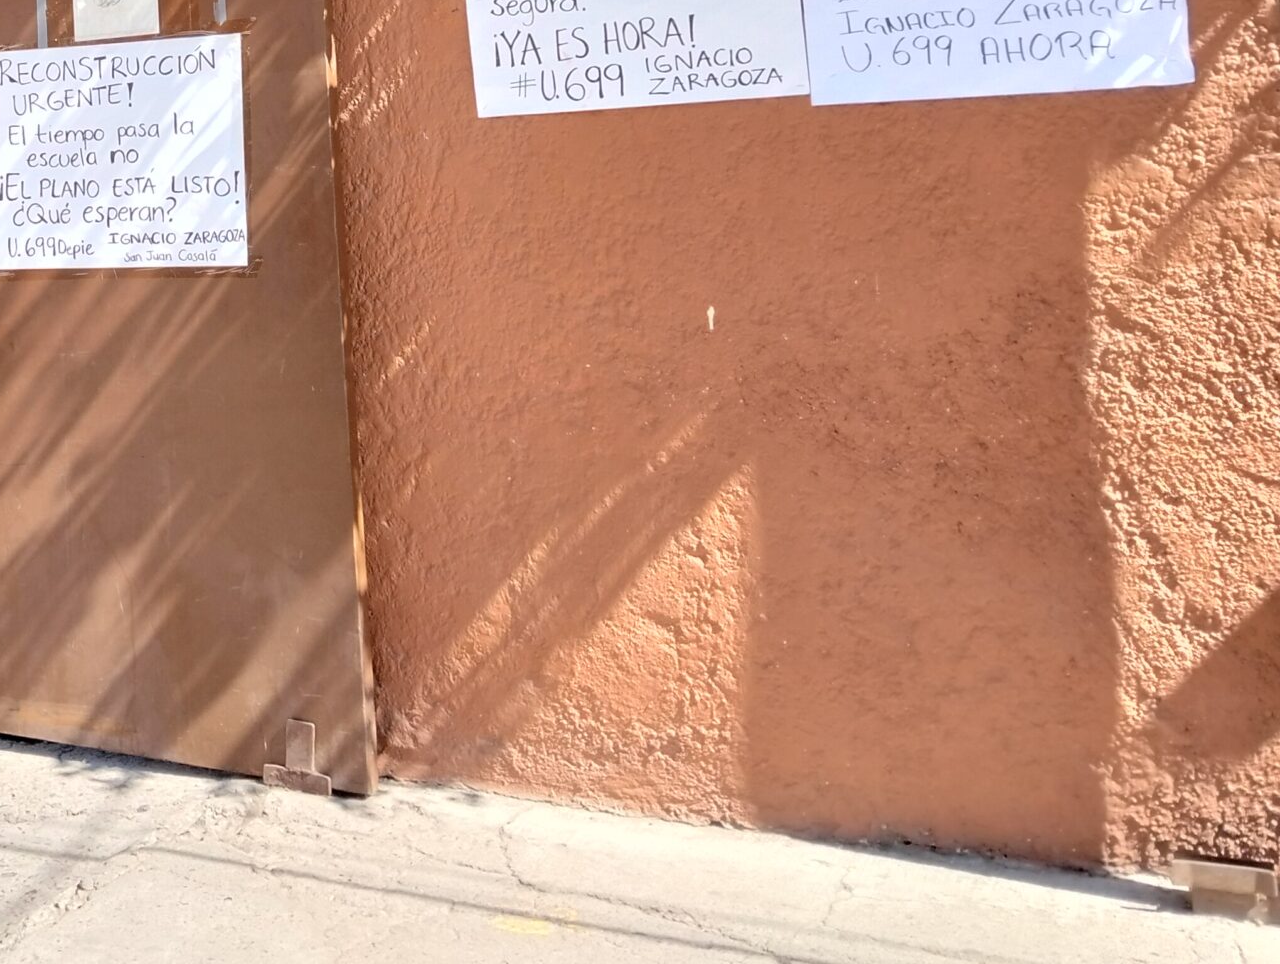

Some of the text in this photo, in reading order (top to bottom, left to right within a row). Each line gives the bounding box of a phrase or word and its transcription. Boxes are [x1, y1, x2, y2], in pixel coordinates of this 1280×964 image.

[836, 8, 975, 37] IGNACIO
[493, 14, 695, 67] ¡YA ES HORA!
[980, 30, 1115, 65] AHORA
[646, 47, 753, 74] IGNACIO
[649, 68, 783, 95] ZARAGOZA
[13, 82, 134, 116] URGENTE!
[8, 112, 194, 150] El tiempo pasa la
[27, 148, 139, 168] escuela no
[0, 168, 240, 205] ¡EL PLANO ESTÁ LISTO!
[13, 197, 176, 228] ¿Qué esperan?
[108, 231, 176, 245] IGNACIO
[184, 229, 245, 244] ZARAGOZA
[124, 251, 142, 263] San
[146, 250, 172, 261] Juan
